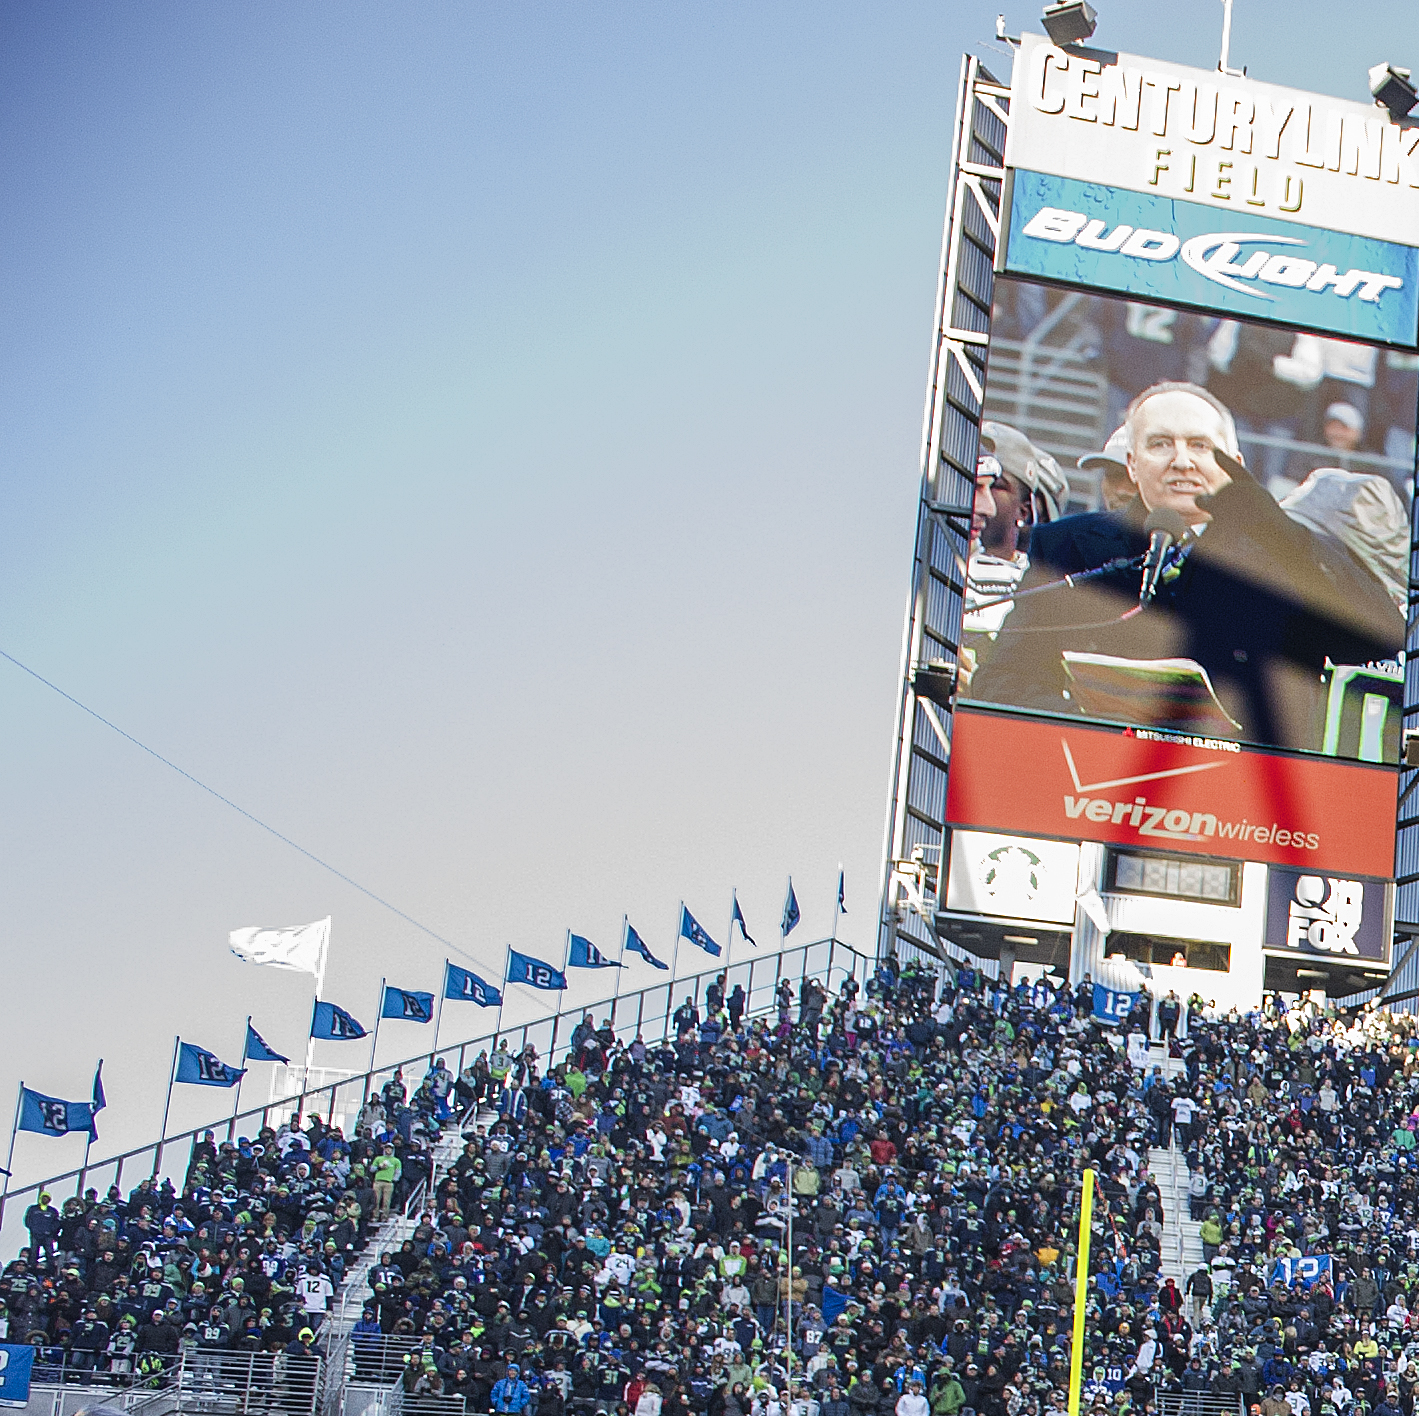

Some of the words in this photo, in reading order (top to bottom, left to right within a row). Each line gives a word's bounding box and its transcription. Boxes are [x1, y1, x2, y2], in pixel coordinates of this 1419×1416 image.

[1148, 148, 1305, 213] FIELD
[1022, 206, 1183, 262] BUD
[1214, 240, 1404, 304] LIGHT
[1124, 302, 1178, 343] 12
[1193, 737, 1242, 753] ELECTRIC
[1063, 794, 1218, 842] verizon
[1217, 817, 1321, 852] wireless
[1286, 914, 1360, 955] FOX
[1104, 990, 1134, 1015] 12
[198, 1053, 228, 1081] 12
[38, 1100, 69, 1131] 12
[614, 1258, 630, 1270] 24
[305, 1281, 321, 1294] 12
[203, 1327, 220, 1340] 89
[806, 1330, 823, 1345] 87
[1105, 1367, 1122, 1383] 10
